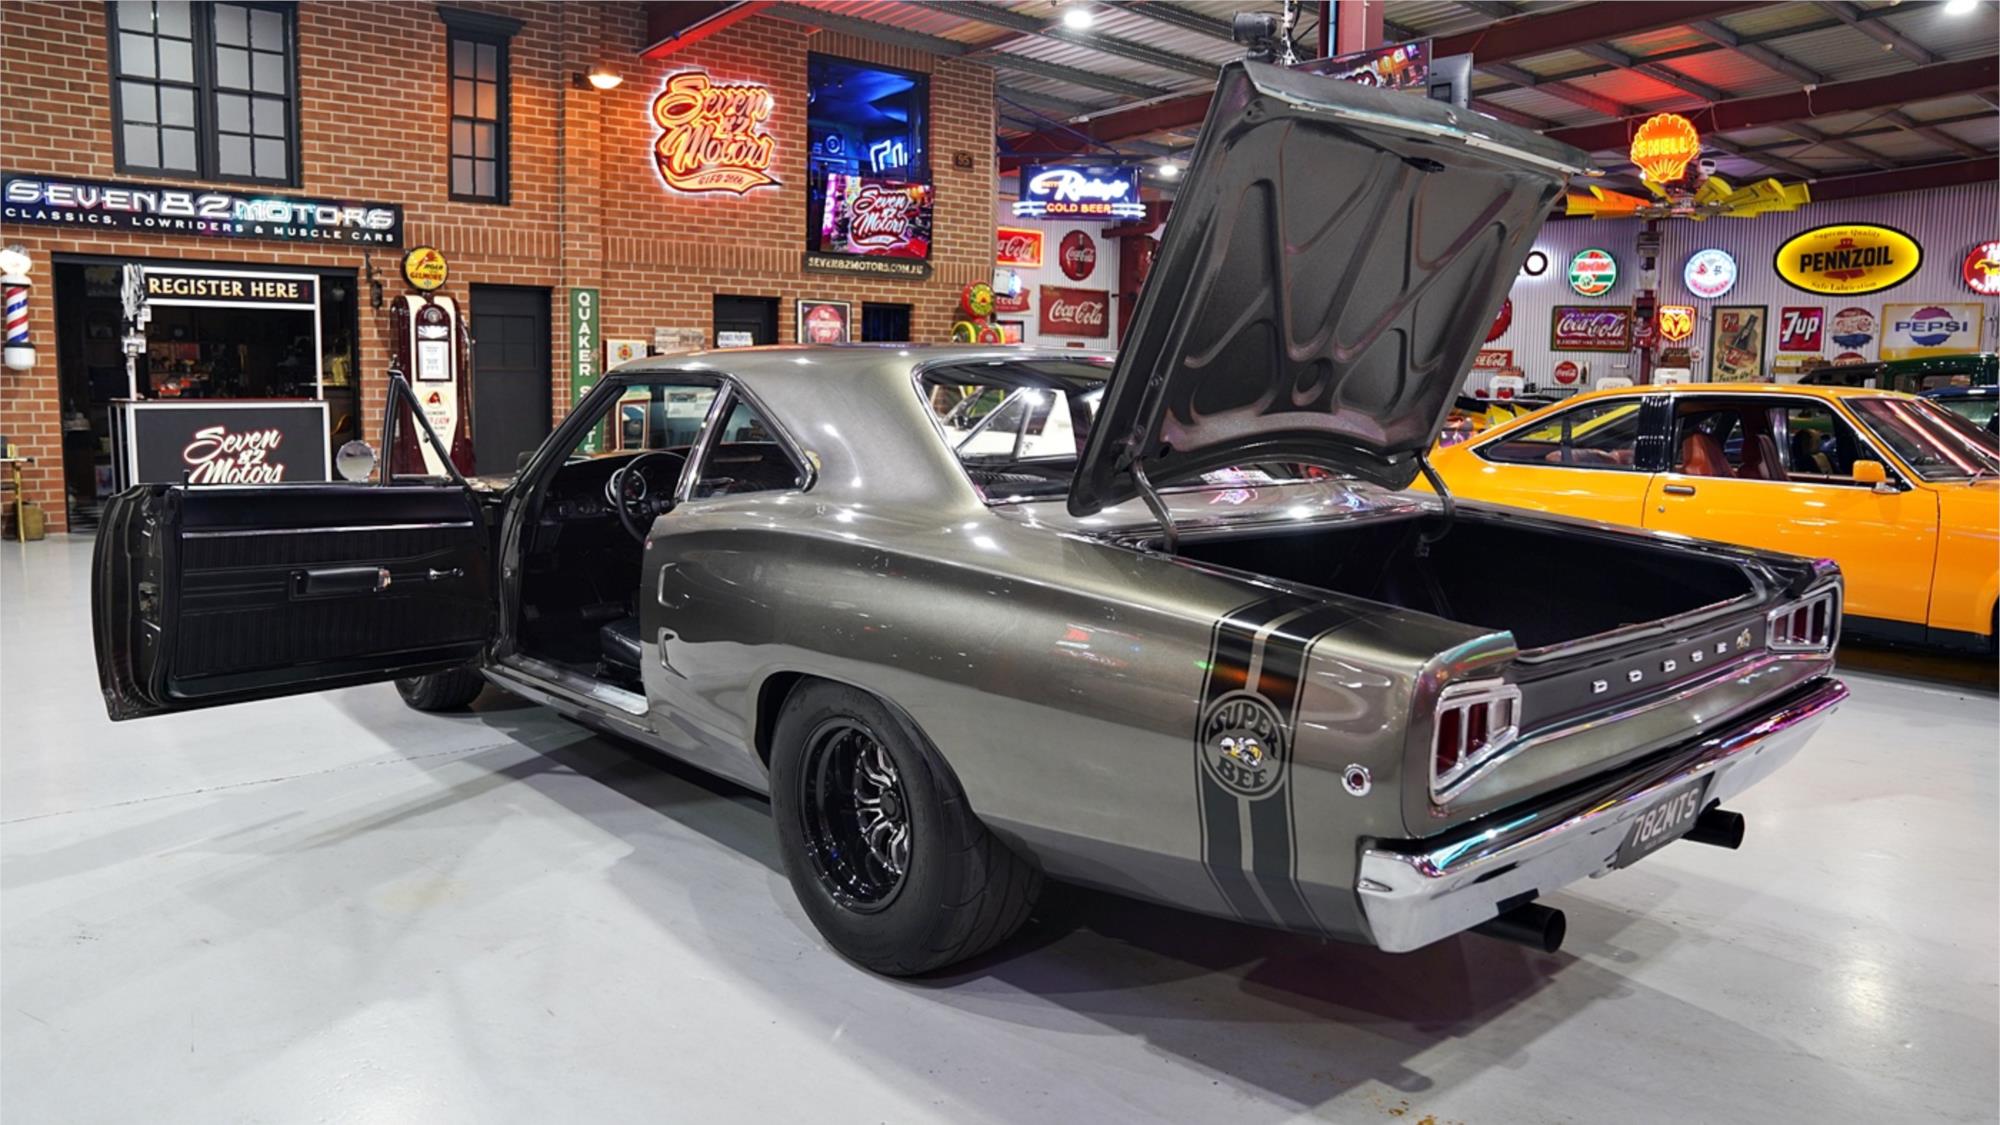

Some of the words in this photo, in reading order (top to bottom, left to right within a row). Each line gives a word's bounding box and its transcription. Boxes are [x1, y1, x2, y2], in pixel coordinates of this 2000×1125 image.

[657, 76, 769, 129] Seven
[660, 124, 775, 173] Motors
[1638, 136, 1688, 158] SHELL
[854, 189, 905, 213] Seven
[1046, 203, 1078, 213] COLD
[1081, 204, 1111, 214] BEER
[5, 207, 117, 226] CLASSICS,
[132, 216, 244, 233] LOWRIDERS
[254, 225, 264, 235] &
[274, 226, 342, 240] MUSCLE
[351, 232, 394, 243] CARS
[854, 211, 904, 236] Motors
[1800, 246, 1893, 273] PENNZOIL
[149, 277, 244, 297] REGISTER
[578, 292, 591, 377] QUAKER
[1895, 320, 1969, 333] PEPSI
[183, 426, 281, 465] Seven
[188, 458, 284, 484] Motors
[1592, 641, 1728, 694] DODGE
[1208, 702, 1279, 760] SUPER
[1216, 755, 1268, 789] BEE
[1631, 787, 1700, 848] 782MTS
